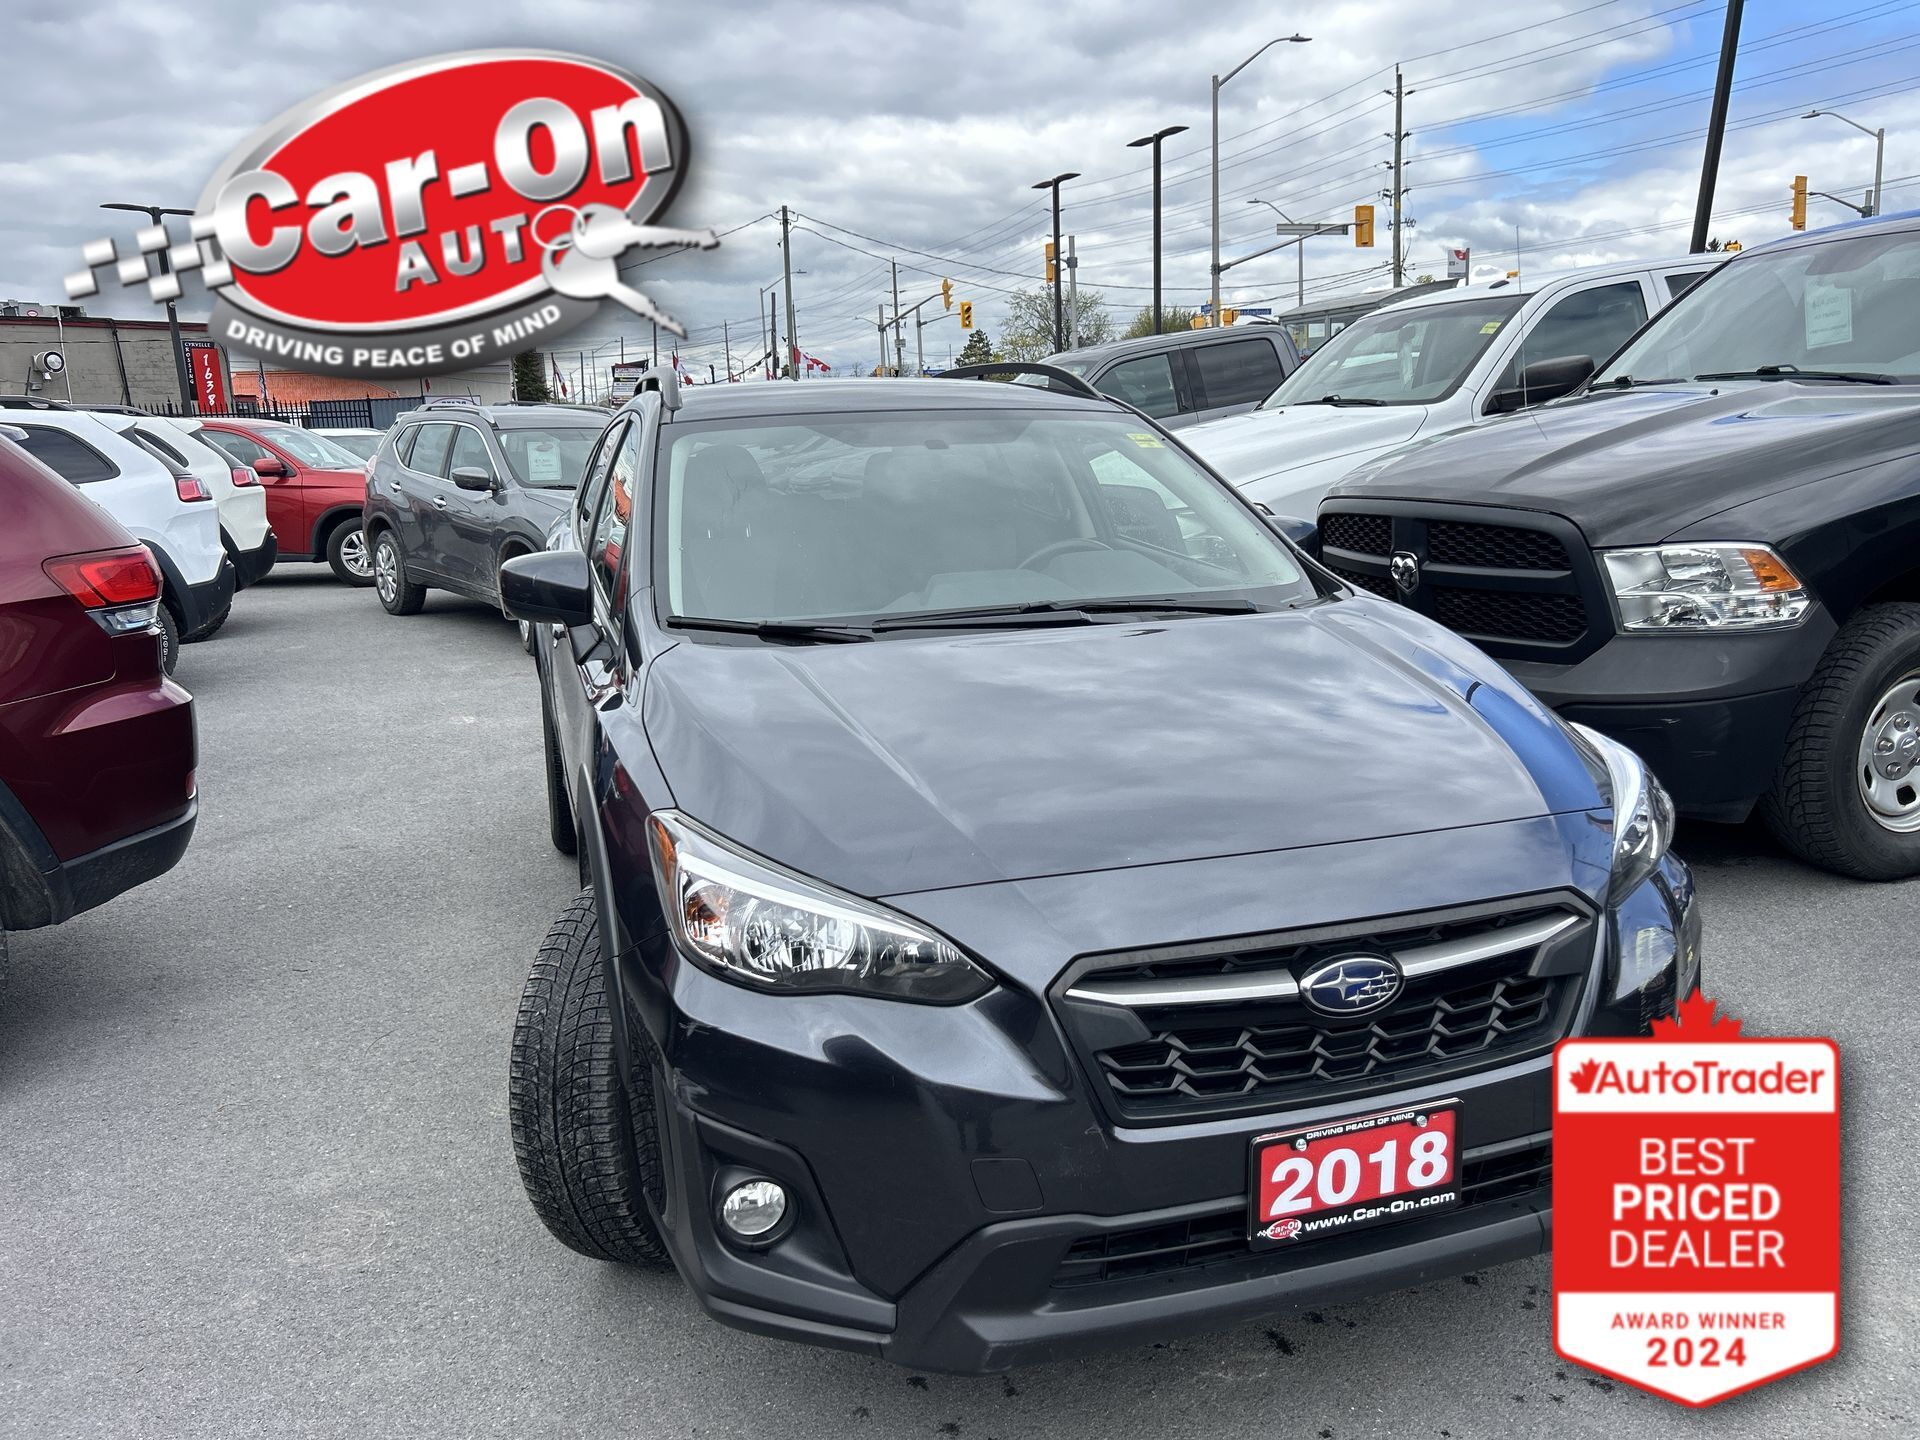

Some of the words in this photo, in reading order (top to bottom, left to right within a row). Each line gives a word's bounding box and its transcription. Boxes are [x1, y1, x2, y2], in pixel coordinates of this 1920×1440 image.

[203, 353, 216, 407] 1638
[1306, 1126, 1344, 1140] DRIVING
[1346, 1120, 1375, 1132] PEACE
[1377, 1116, 1390, 1125] OF
[1391, 1112, 1415, 1122] MIND
[1270, 1131, 1448, 1216] 2018
[1305, 1192, 1455, 1231] www.Car-On.com
